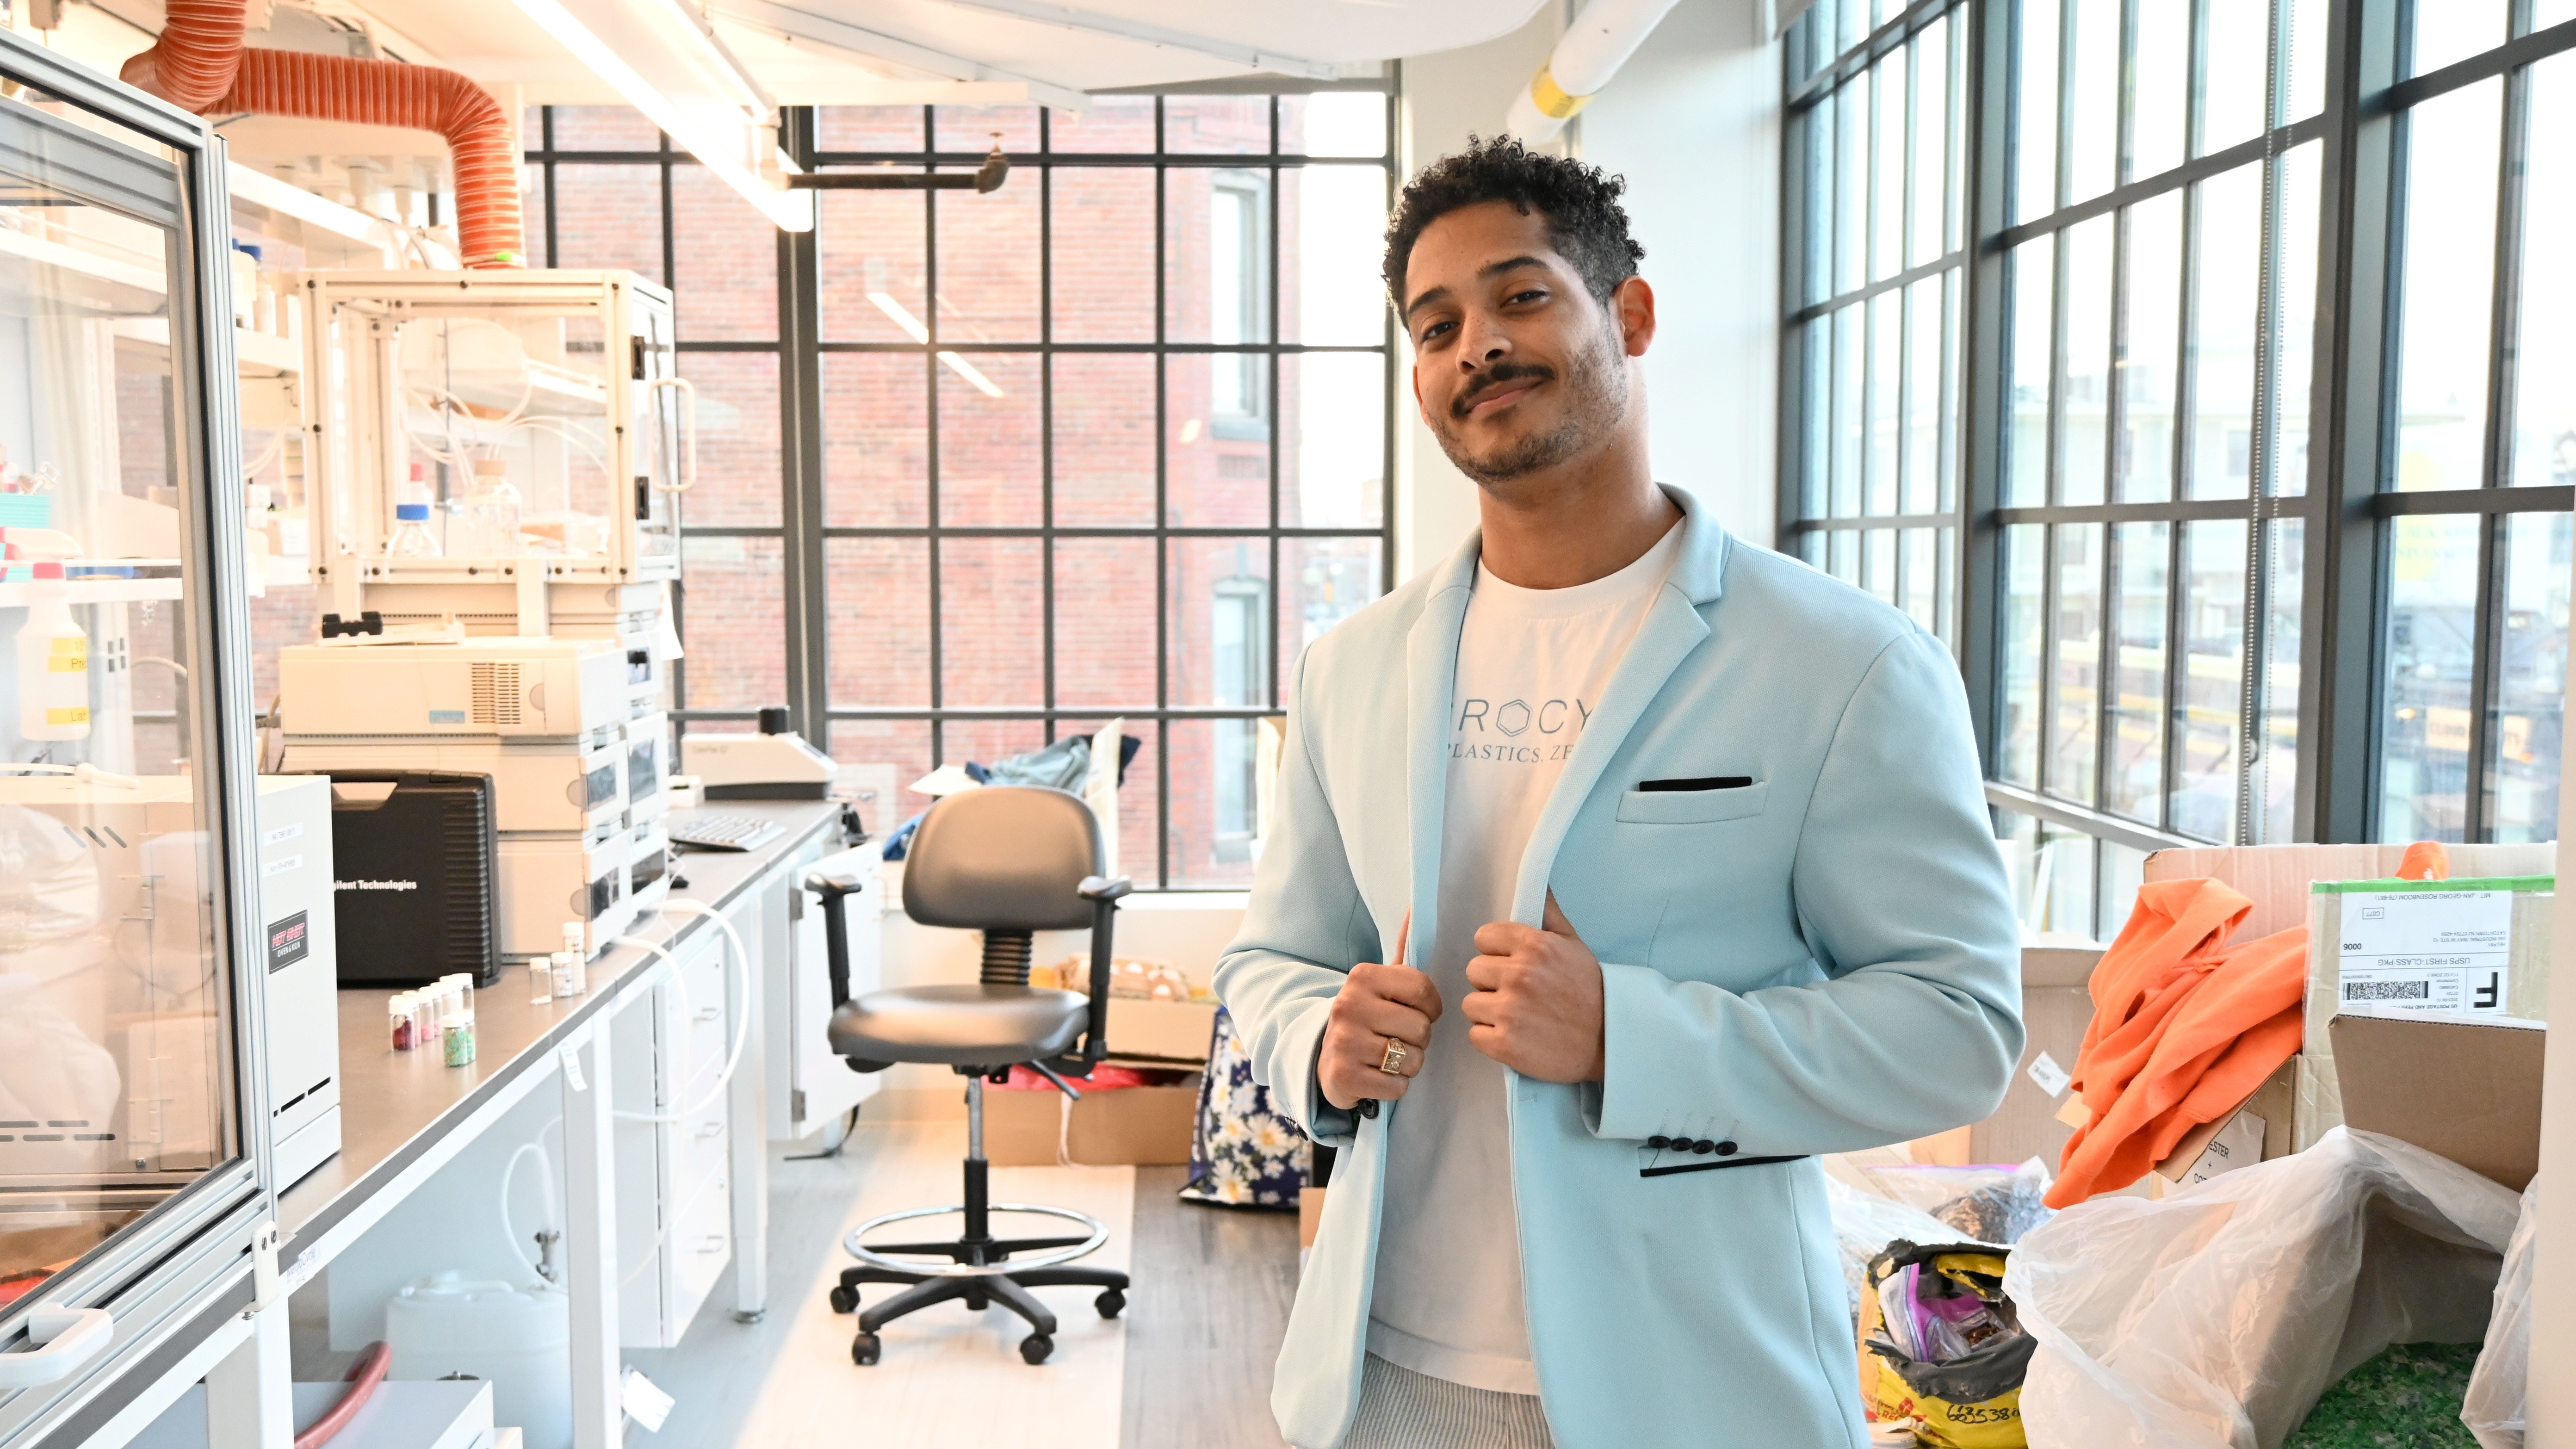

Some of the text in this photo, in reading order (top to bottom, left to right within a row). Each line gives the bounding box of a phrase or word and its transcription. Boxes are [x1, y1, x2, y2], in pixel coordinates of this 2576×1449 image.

[1451, 699, 1593, 737] ROCY
[1448, 743, 1544, 762] LASTICS,
[358, 879, 417, 891] Technologies
[272, 923, 305, 947] HOT SHOT
[278, 947, 288, 957] OVEN
[292, 941, 300, 950] KILN
[2473, 972, 2498, 1009] F
